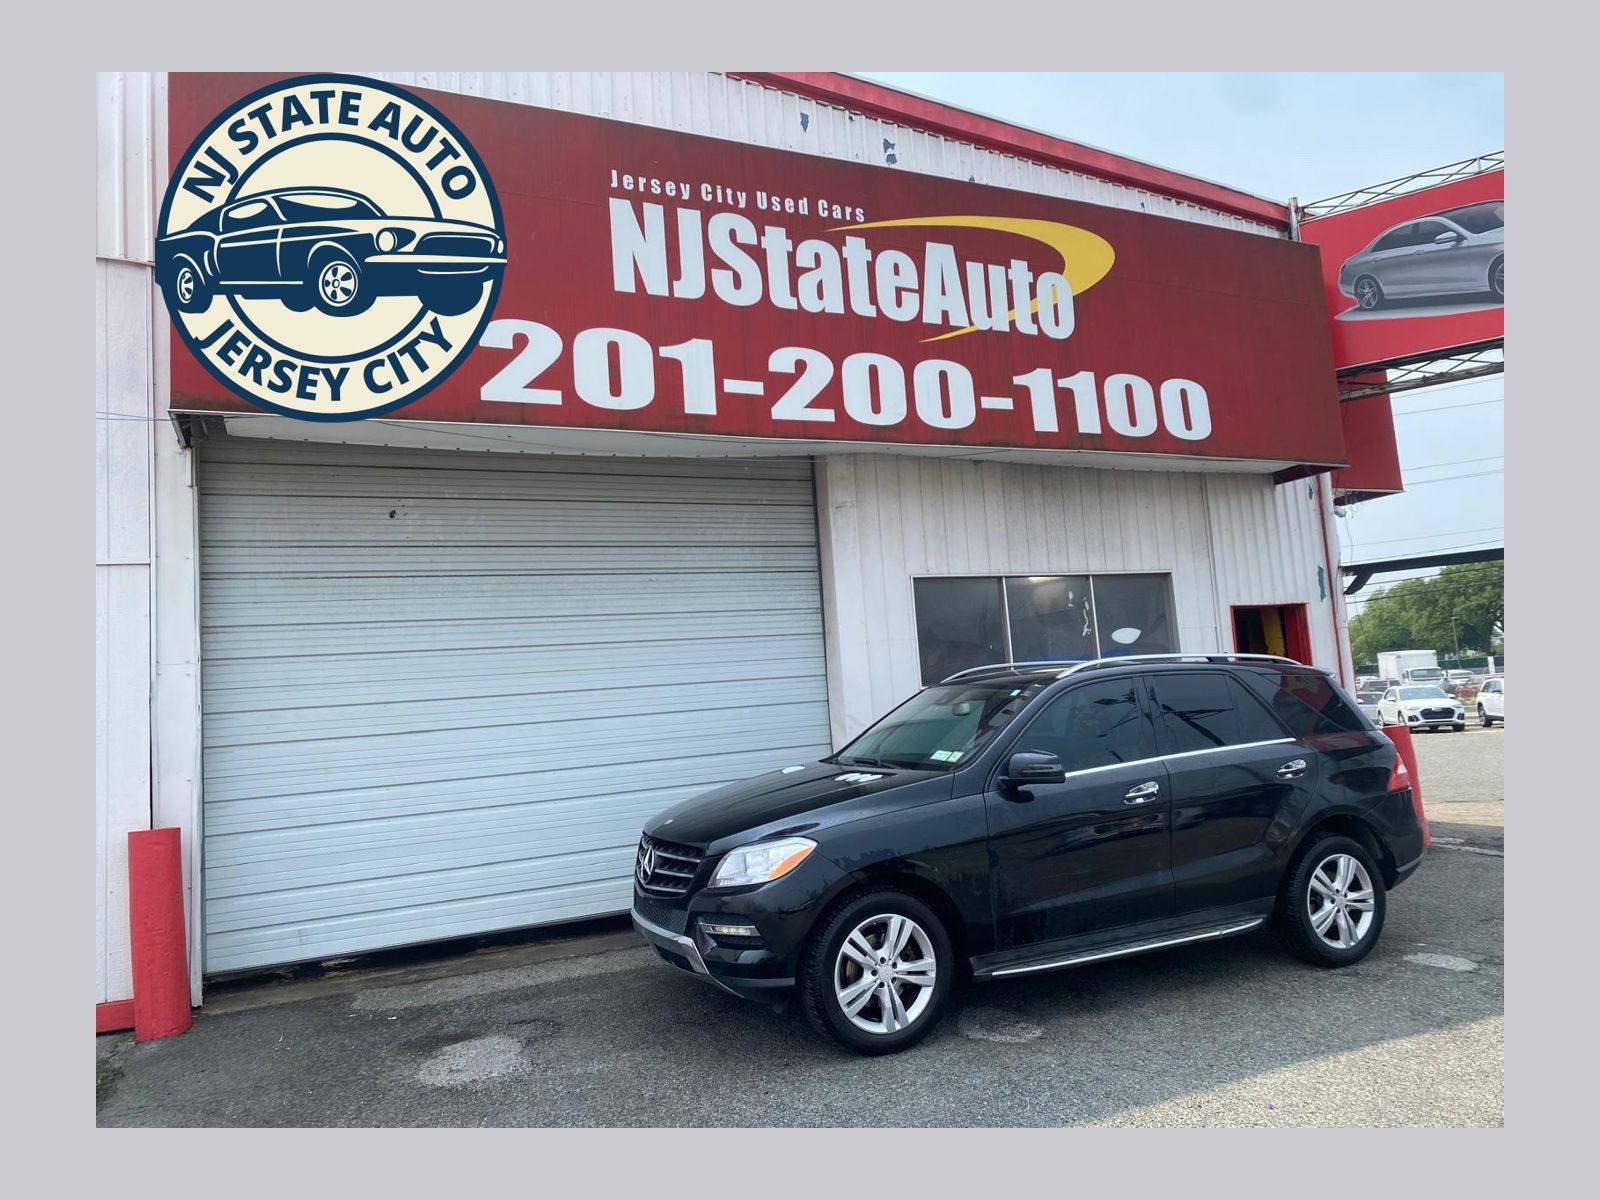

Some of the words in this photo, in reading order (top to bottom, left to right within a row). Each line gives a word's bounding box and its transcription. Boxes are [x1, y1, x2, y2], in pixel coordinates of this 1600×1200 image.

[610, 169, 692, 201] Jersey
[700, 183, 747, 210] City
[756, 190, 809, 216] Used
[817, 198, 867, 223] Cars
[608, 197, 1076, 340] NJStateAuto
[479, 318, 1213, 442] 201-200-1100
